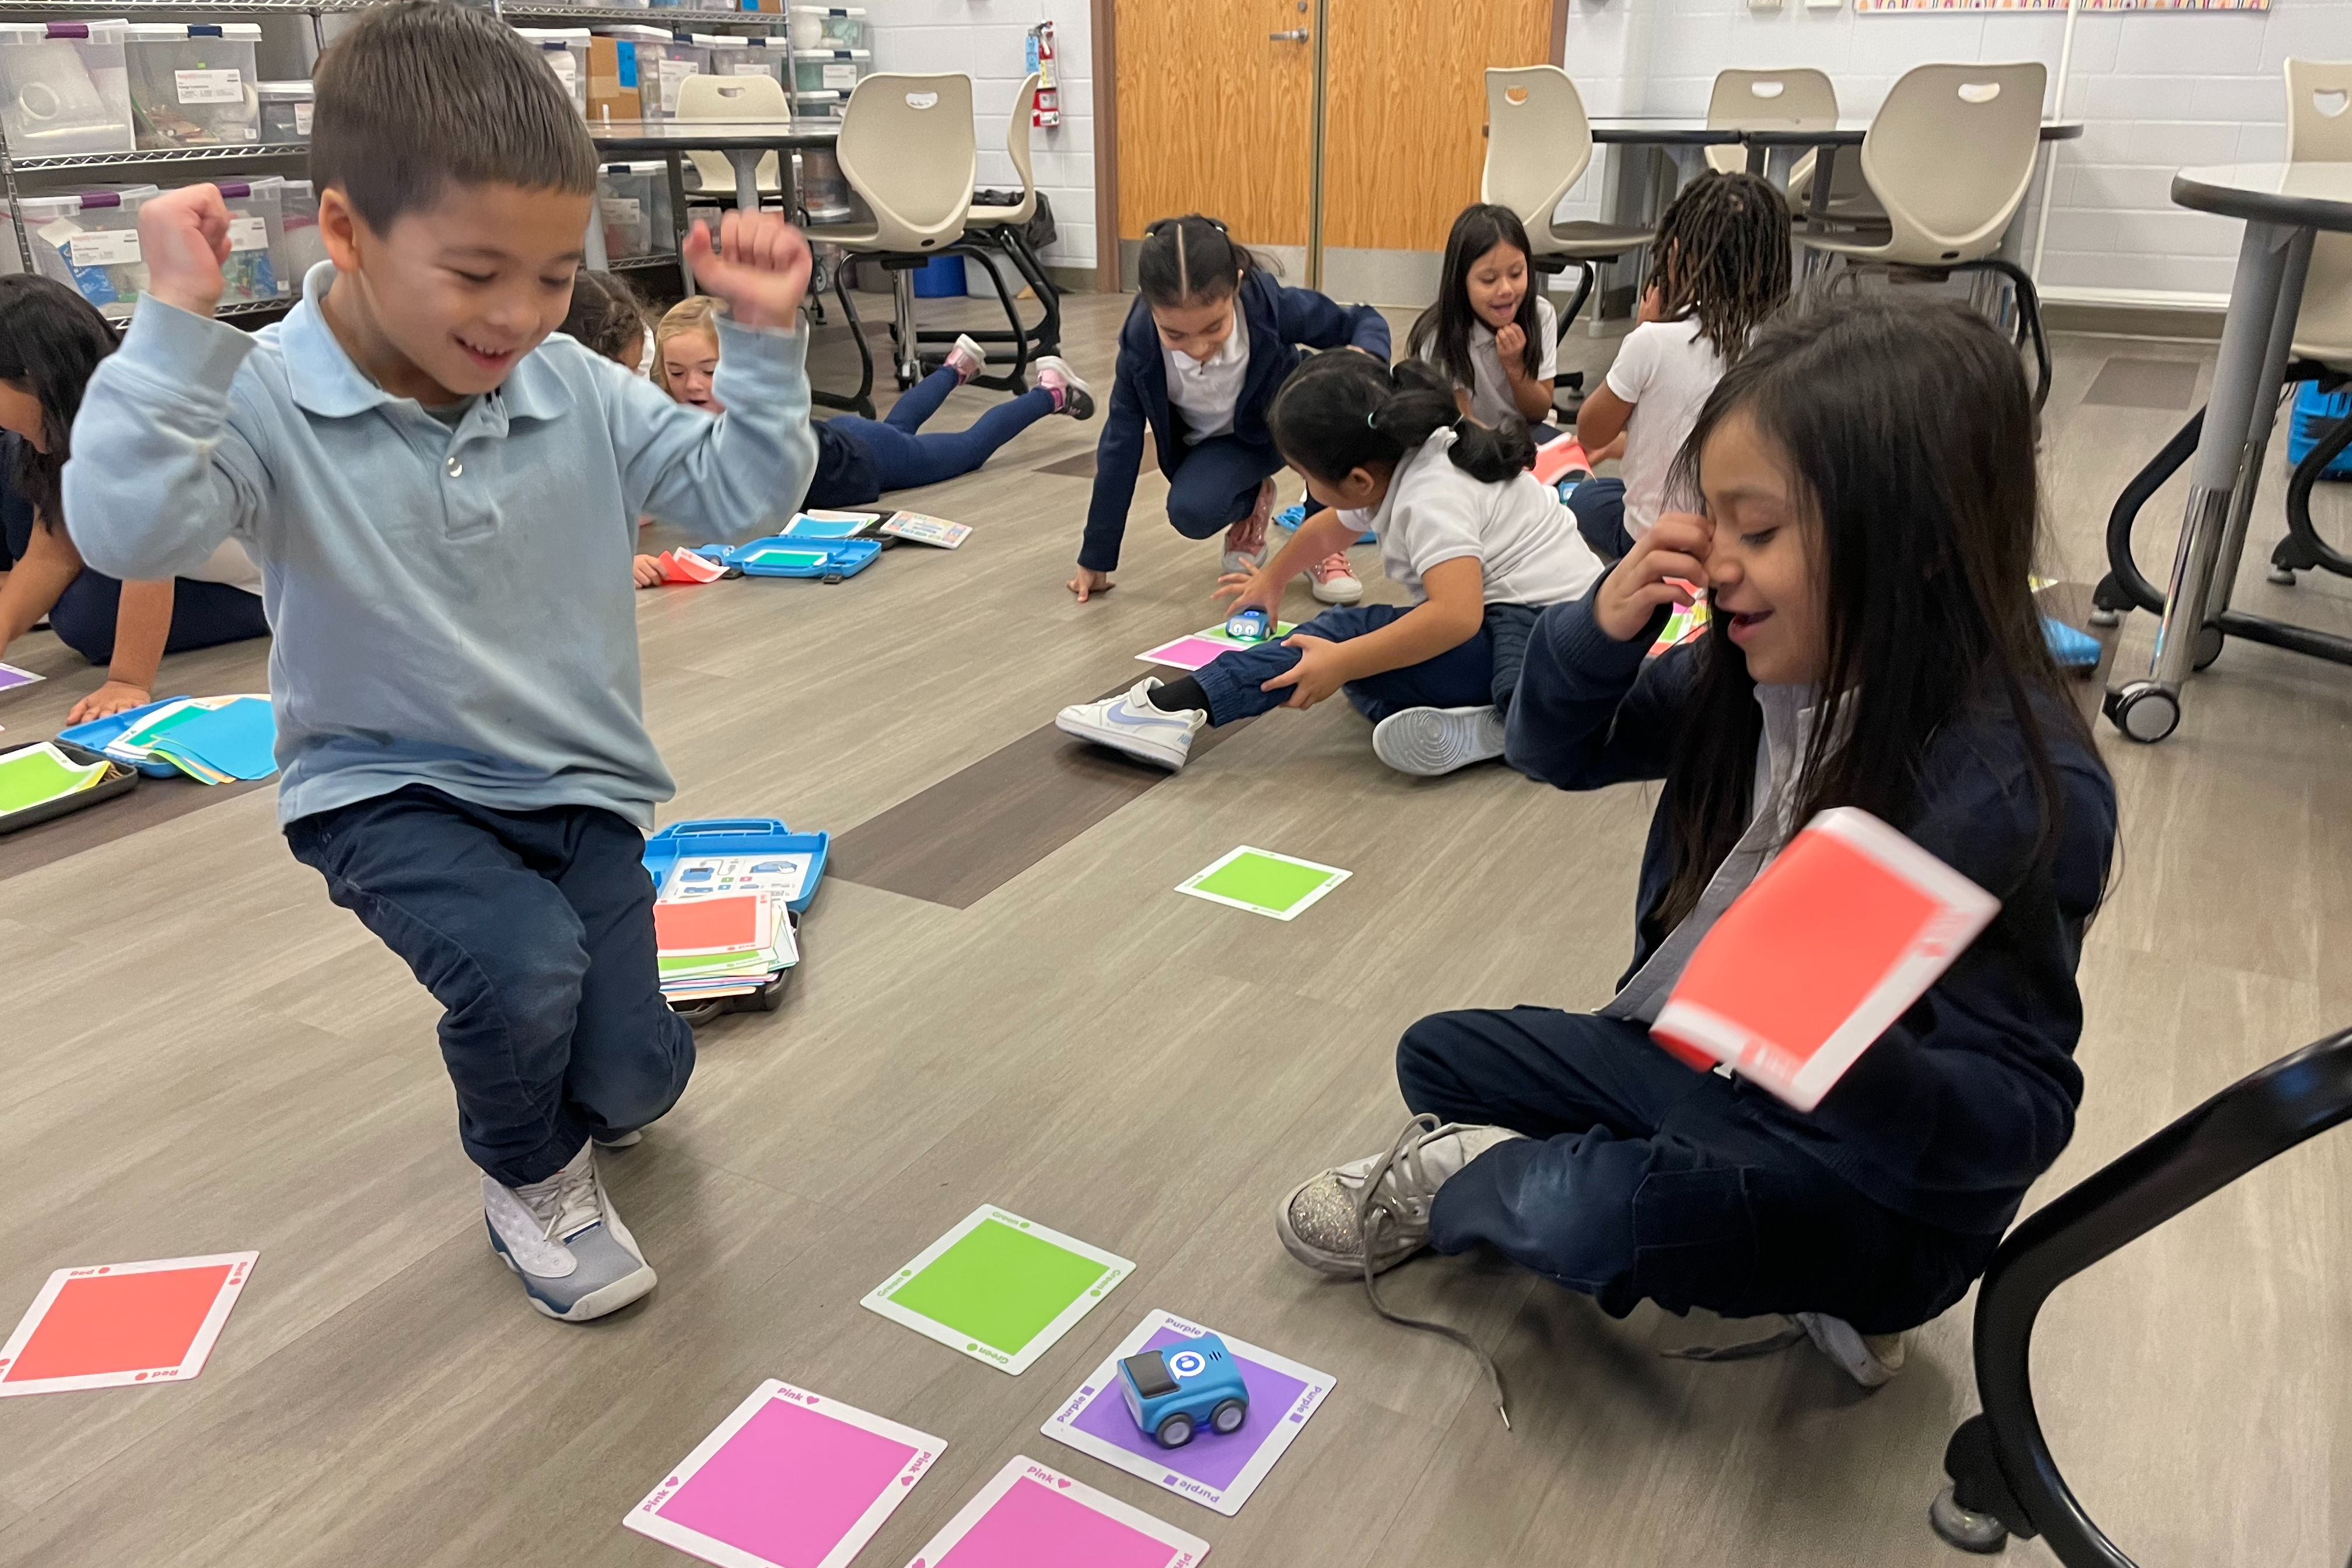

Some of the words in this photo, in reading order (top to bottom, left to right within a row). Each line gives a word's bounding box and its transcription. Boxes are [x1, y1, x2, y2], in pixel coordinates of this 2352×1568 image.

[992, 1211, 1019, 1226] Green
[877, 1277, 904, 1297] Green
[1097, 1269, 1121, 1290] Green
[1165, 1317, 1202, 1335] Purple
[978, 1348, 1009, 1364] Green
[152, 1370, 178, 1378] Red
[777, 1387, 803, 1401] Pink
[1297, 1385, 1322, 1413] Purple
[1056, 1395, 1086, 1423] Purple
[908, 1451, 932, 1474] Pink
[1027, 1466, 1054, 1484] Pink
[642, 1489, 670, 1513] Pink
[1180, 1480, 1220, 1503] Purple
[1173, 1552, 1193, 1568] Pin
